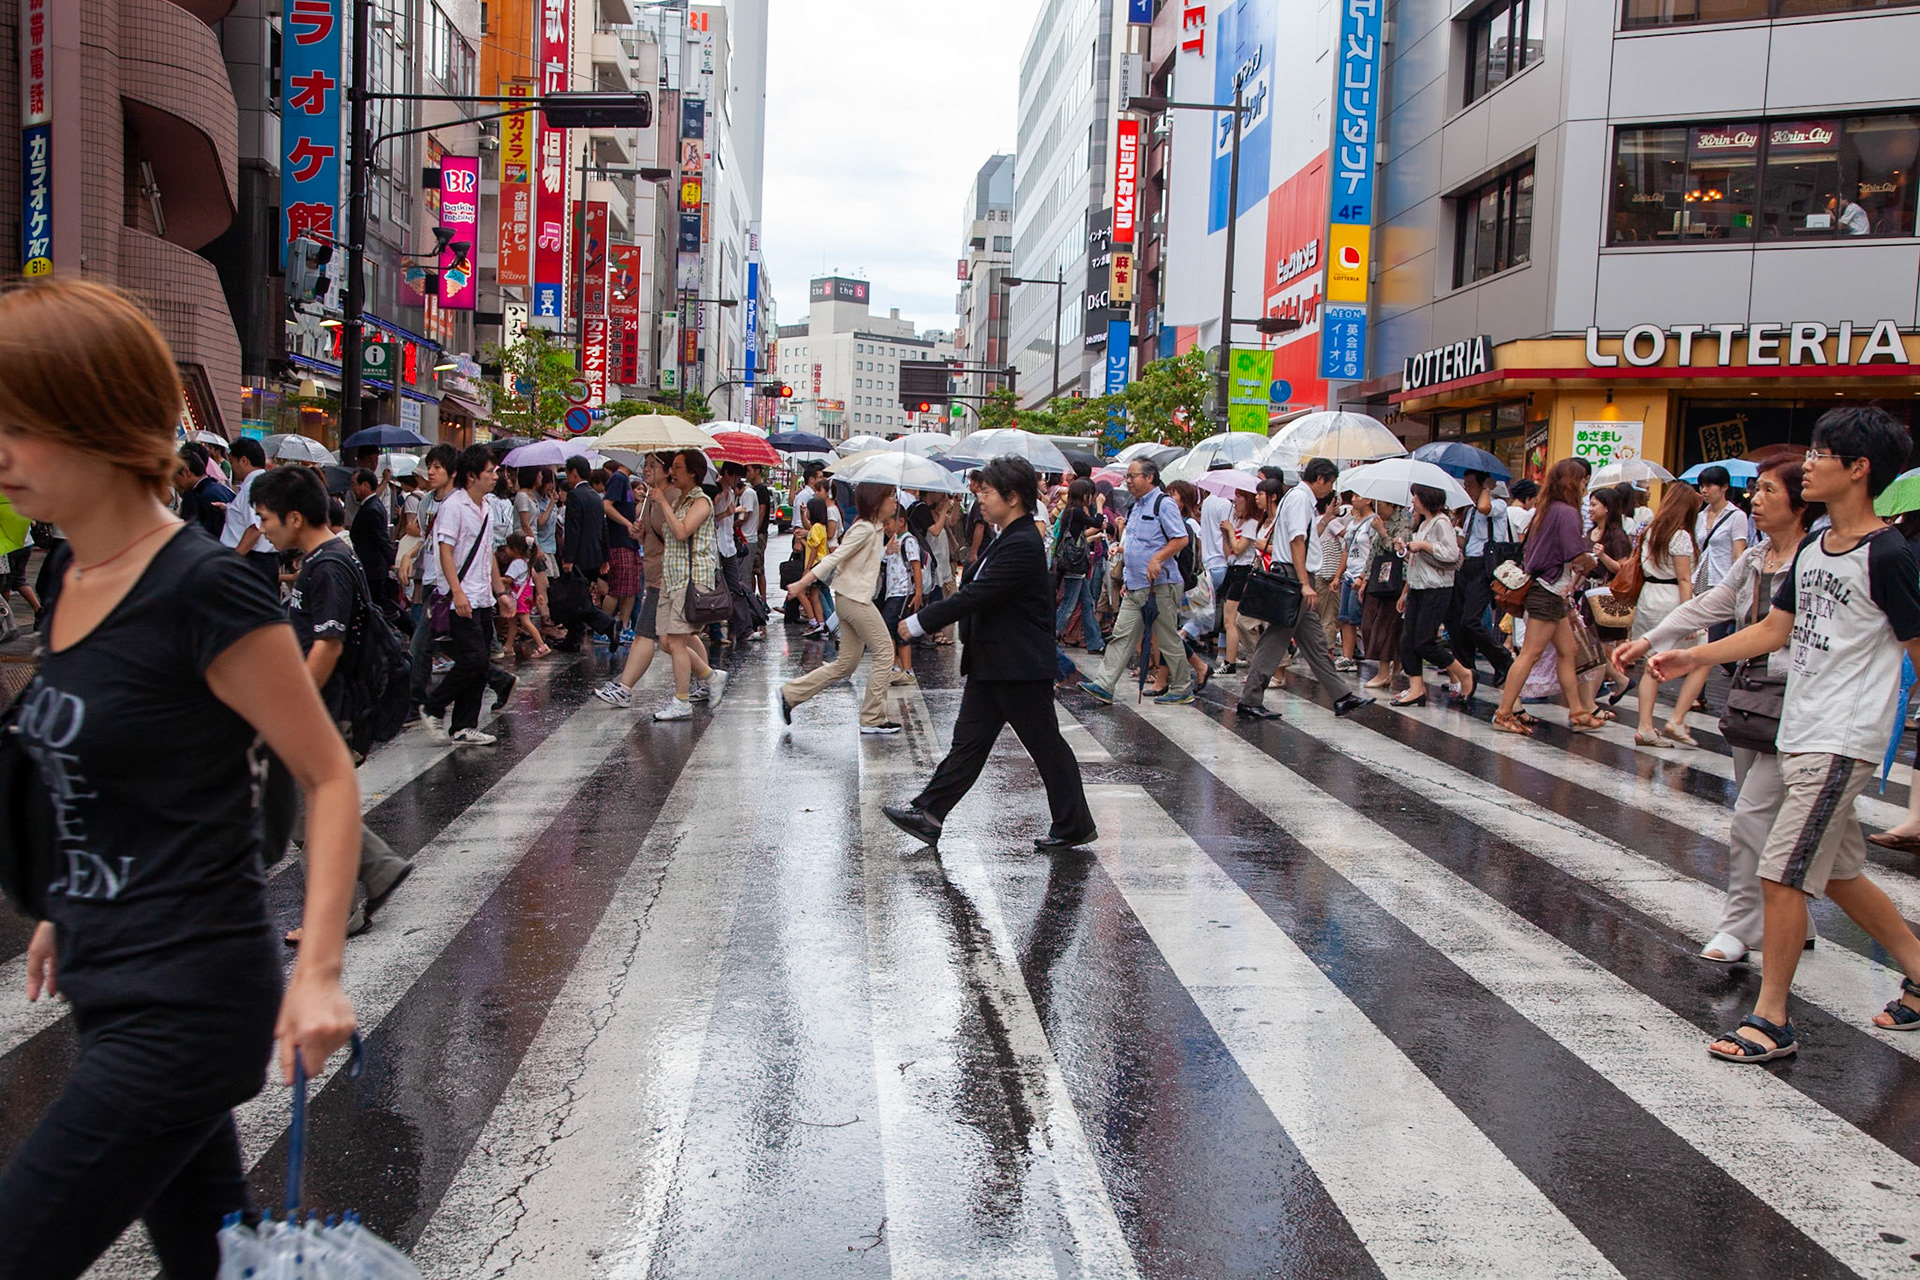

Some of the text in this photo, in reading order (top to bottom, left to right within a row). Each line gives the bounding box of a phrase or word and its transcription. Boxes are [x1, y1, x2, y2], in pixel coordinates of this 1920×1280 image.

[1182, 0, 1206, 56] ET
[1220, 80, 1266, 149] アレット
[513, 191, 528, 252] お部屋探しの
[1339, 204, 1363, 219] 4F
[501, 222, 512, 266] パートナー
[1115, 256, 1129, 284] 麻雀
[1331, 309, 1361, 320] AEON
[1329, 323, 1341, 374] イーオン
[1346, 324, 1358, 363] 英会話
[1403, 335, 1486, 392] LOTTERIA
[1586, 319, 1909, 368] LOTTERIA
[1576, 443, 1612, 456] one
[1577, 430, 1622, 442] めざまし
